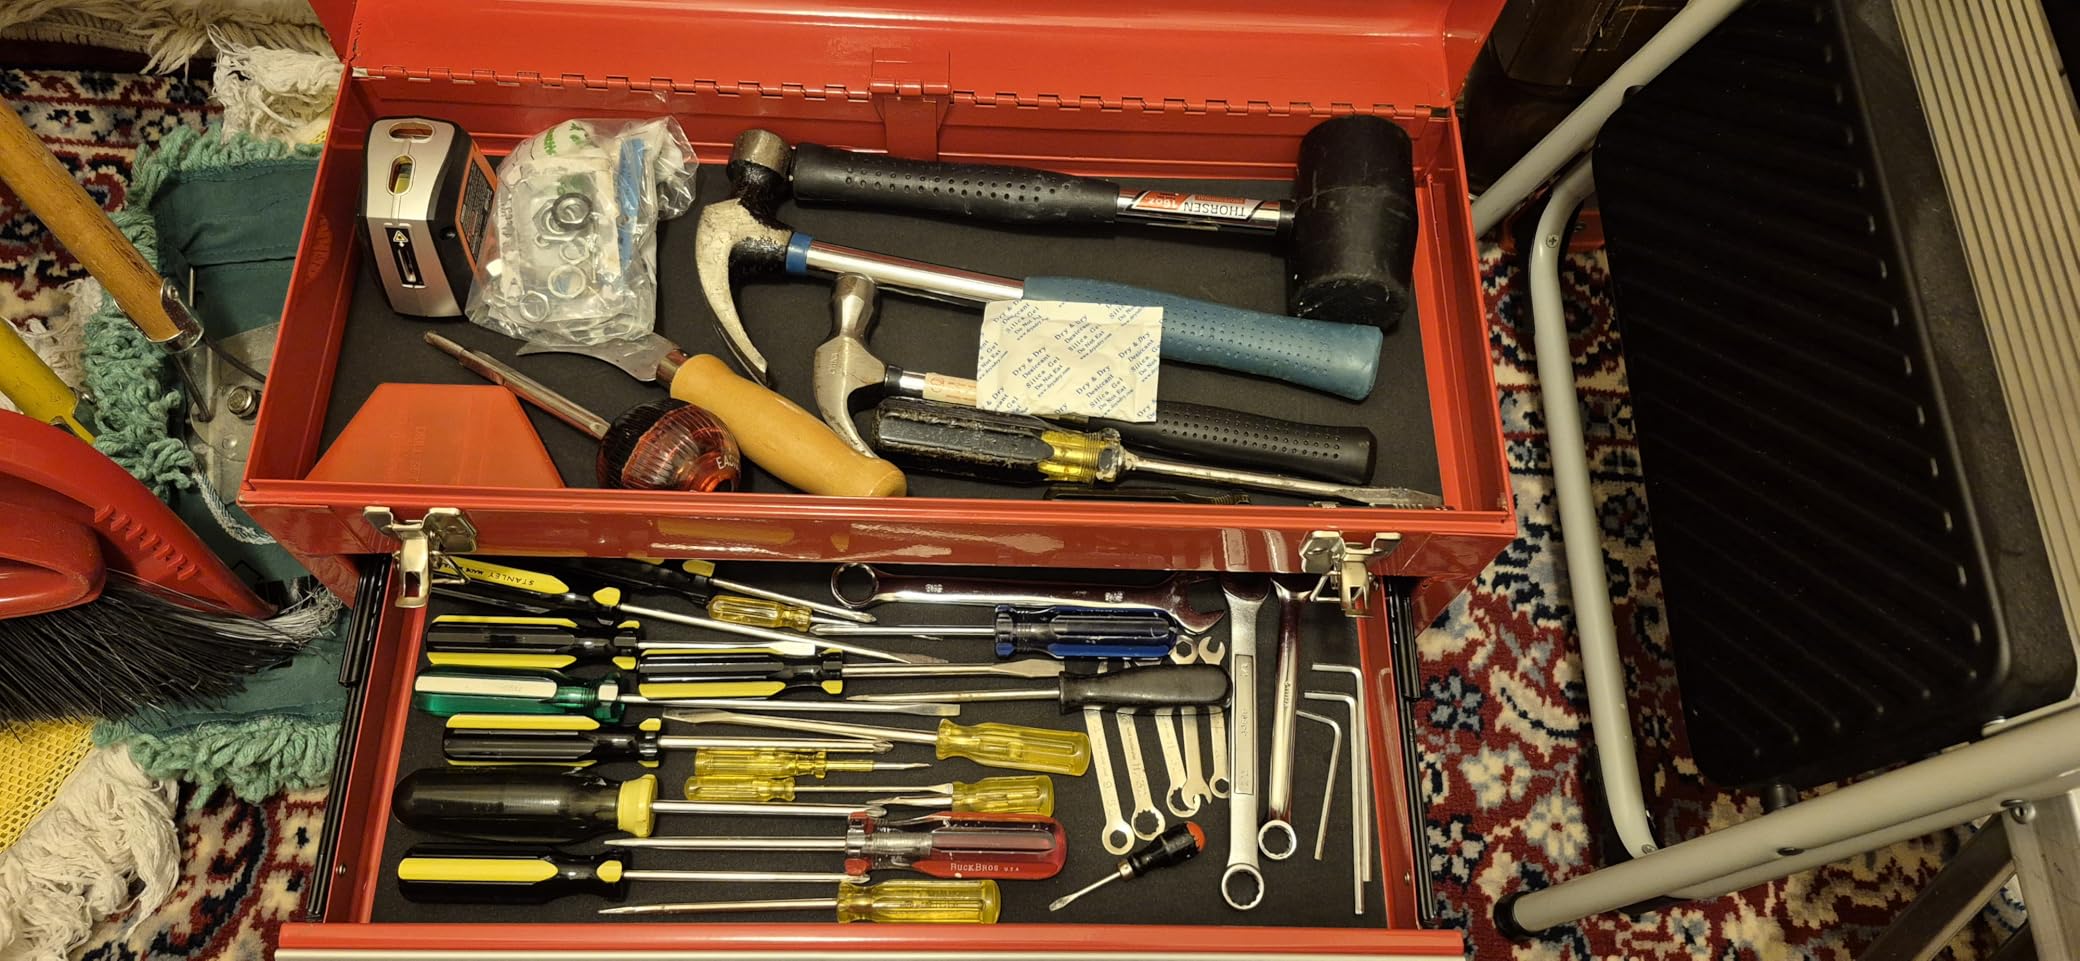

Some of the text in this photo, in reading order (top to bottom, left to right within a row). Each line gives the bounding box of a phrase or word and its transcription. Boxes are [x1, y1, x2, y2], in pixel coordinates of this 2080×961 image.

[1184, 201, 1246, 217] THORSEN
[1054, 327, 1068, 340] Dry
[1084, 338, 1094, 347] Not
[1012, 363, 1026, 376] Dry
[1032, 344, 1047, 358] Dry
[1118, 346, 1132, 358] Dry
[1021, 352, 1051, 379] Desiccant
[1025, 355, 1060, 388] Silica Gel
[1034, 363, 1063, 390] Do Not Eat
[1075, 381, 1090, 395] Dry
[1096, 363, 1111, 377] Dry
[1086, 373, 1114, 398] Desiccant
[991, 386, 1005, 399] Dry
[1089, 376, 1123, 407] Silica Gel
[1105, 393, 1116, 403] Not
[1116, 384, 1126, 394] Eat
[488, 571, 535, 586] STANLEY
